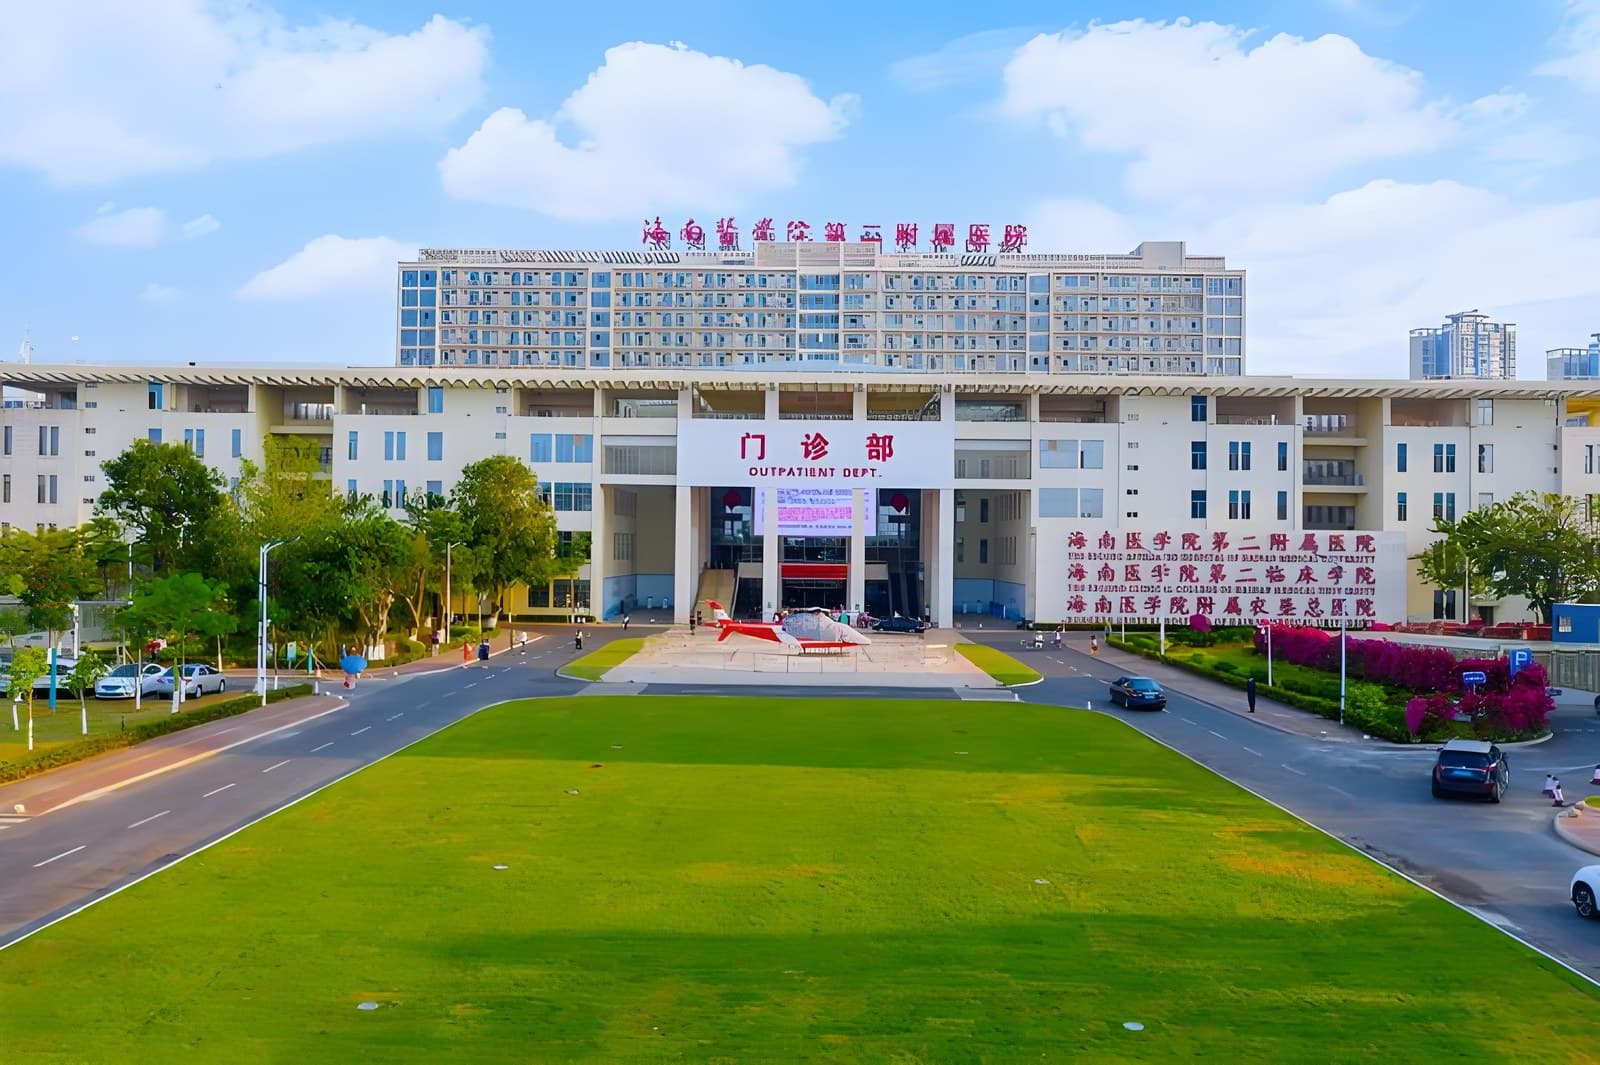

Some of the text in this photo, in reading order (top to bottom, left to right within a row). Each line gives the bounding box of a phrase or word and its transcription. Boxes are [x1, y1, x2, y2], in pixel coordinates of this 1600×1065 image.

[740, 432, 894, 462] 门诊部
[749, 467, 835, 477] OUTPATIENT
[1067, 530, 1376, 551] 海南医学院第二附属医院
[1067, 562, 1376, 585] 海南医学院第二临床学院
[1515, 651, 1528, 666] P
